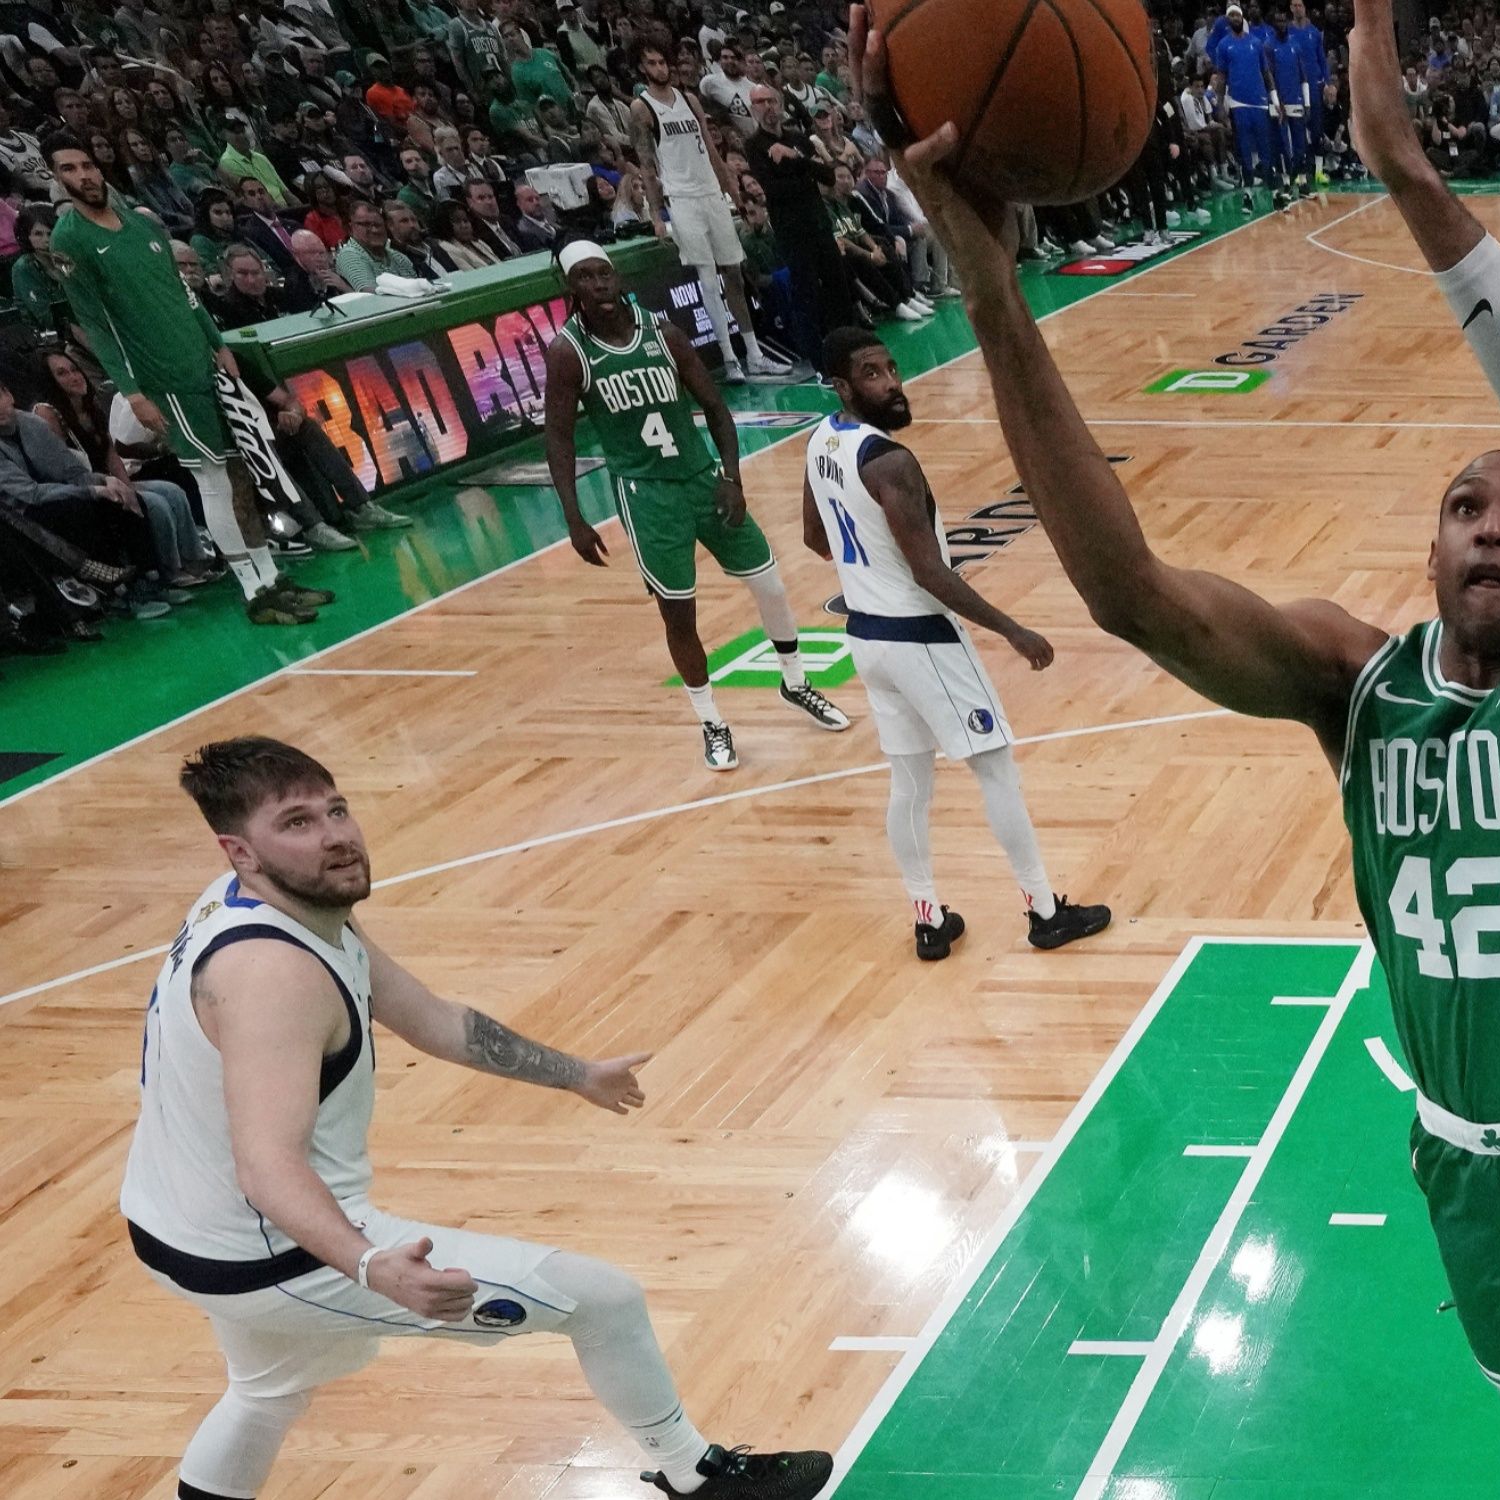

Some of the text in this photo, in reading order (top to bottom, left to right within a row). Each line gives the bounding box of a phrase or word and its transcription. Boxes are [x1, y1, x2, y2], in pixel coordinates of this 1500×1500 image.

[662, 119, 699, 136] DALLAS
[670, 282, 699, 309] NOW
[1213, 293, 1364, 366] GARDEN
[284, 340, 468, 493] BAD
[447, 297, 572, 432] BOY
[595, 366, 678, 414] BOSTON
[641, 411, 679, 458] 4
[829, 497, 870, 567] 11
